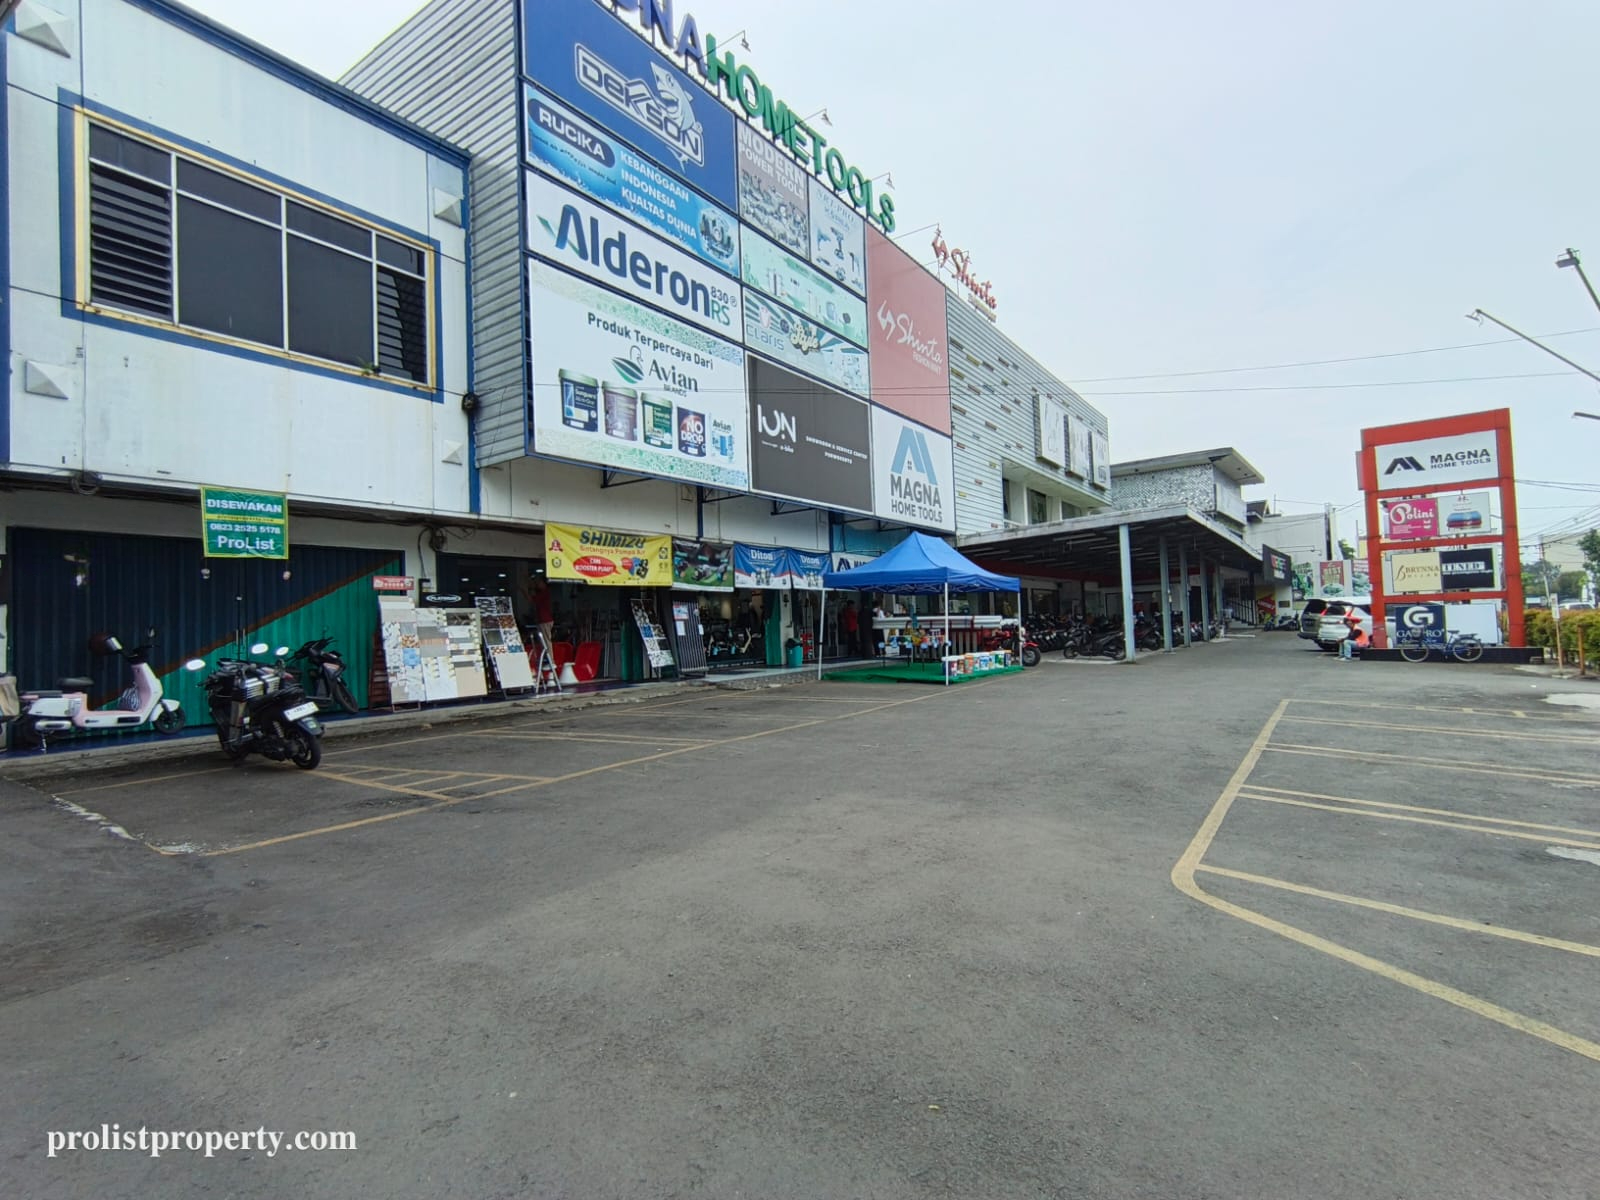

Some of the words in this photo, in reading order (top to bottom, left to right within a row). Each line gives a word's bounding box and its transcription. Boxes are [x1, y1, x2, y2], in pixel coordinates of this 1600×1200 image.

[577, 52, 702, 160] DEKSON
[539, 107, 605, 160] RUCIKA
[620, 151, 689, 202] KEBANGGAAN
[741, 144, 774, 177] POWER
[776, 171, 805, 200] TOOLS
[621, 168, 677, 210] INDONESIA
[667, 212, 697, 239] DUNIA
[555, 203, 710, 318] Alderon
[711, 300, 730, 326] RS
[588, 312, 631, 340] Produk
[634, 329, 692, 362] Terpercaya
[694, 353, 714, 370] Dari
[649, 359, 699, 393] Avian
[680, 432, 704, 446] DROP
[687, 419, 704, 434] NO
[1430, 449, 1490, 463] MAGNA
[1431, 461, 1457, 469] HOME
[1461, 457, 1491, 465] TOOLS
[890, 473, 942, 508] MAGNA
[207, 499, 282, 513] DISEWAKAN
[891, 499, 916, 518] HOME
[917, 504, 943, 523] TOOLS
[1390, 503, 1434, 524] Polini
[217, 535, 275, 550] ProList
[580, 530, 646, 549] SHIMIZU
